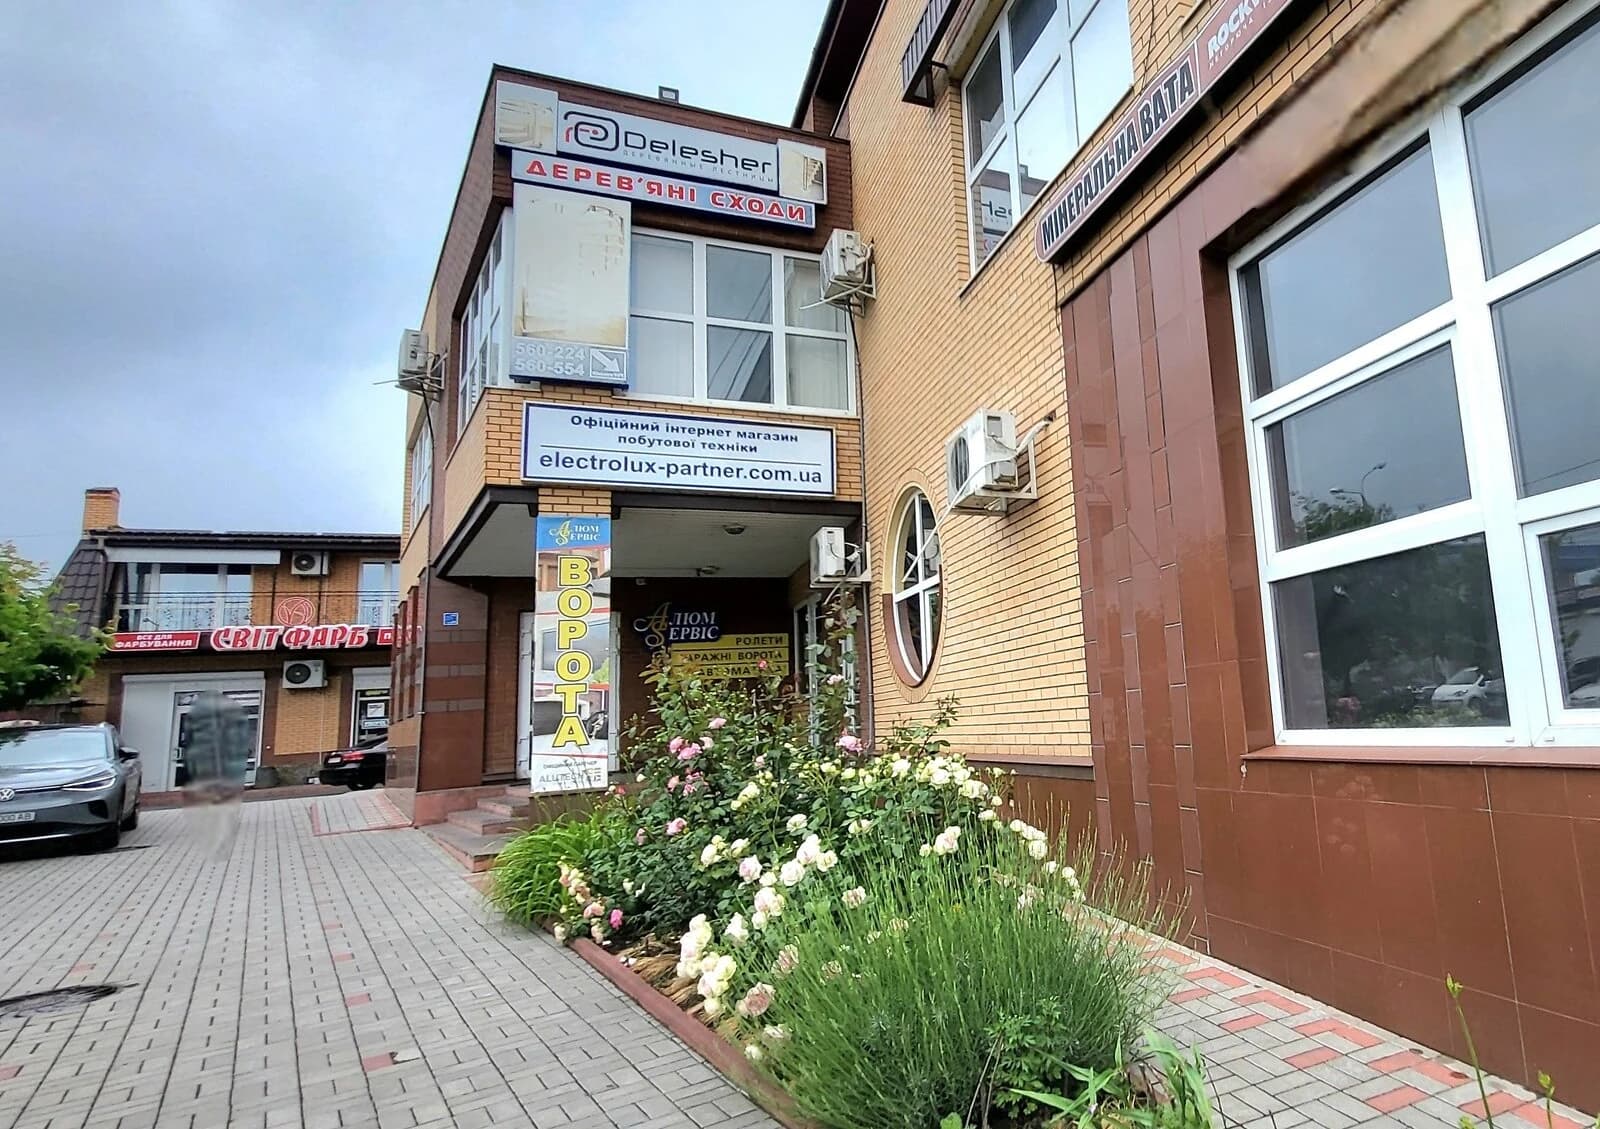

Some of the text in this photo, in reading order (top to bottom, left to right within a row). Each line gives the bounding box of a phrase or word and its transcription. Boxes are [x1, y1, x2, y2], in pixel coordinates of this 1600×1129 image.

[624, 131, 772, 173] Delesher
[1041, 58, 1195, 251] МІНЕРАЛЬНА ВАТА
[623, 150, 774, 183] ДЕРЕВЯННЫЕ ЛЕСТНИЦЫ
[526, 159, 806, 222] ДЕРЕВ'ЯНІ СХОДИ
[515, 343, 586, 361] 560-224
[514, 358, 585, 376] 560-554
[570, 415, 798, 443] Офіційний інтернет магазин
[618, 434, 758, 453] побутової техніки
[539, 452, 822, 484] electrolux-partner.com.ua
[115, 639, 193, 648] ФАРБУВАННЯ
[211, 624, 368, 650] СВІТ ФАРБ
[735, 636, 783, 646] РОЛЕТИ
[552, 555, 593, 748] ВОРОТА
